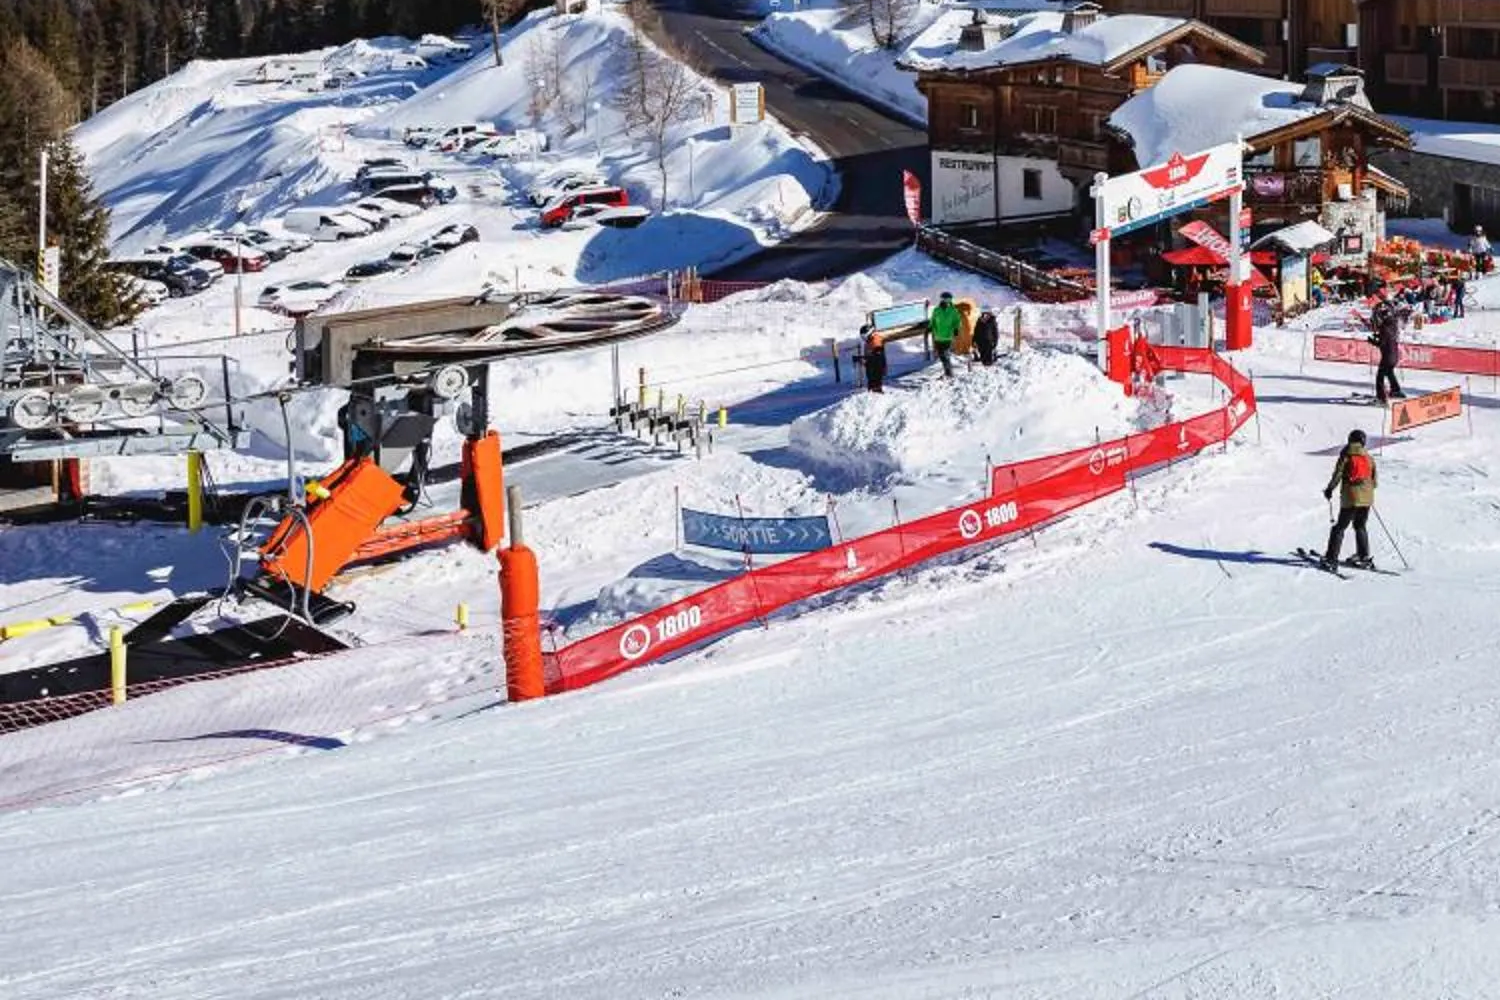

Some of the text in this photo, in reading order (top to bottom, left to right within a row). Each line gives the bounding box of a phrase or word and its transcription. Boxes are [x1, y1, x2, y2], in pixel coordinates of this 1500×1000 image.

[984, 501, 1018, 527] 1800
[723, 525, 781, 545] SORTIE
[655, 605, 701, 641] 1800
